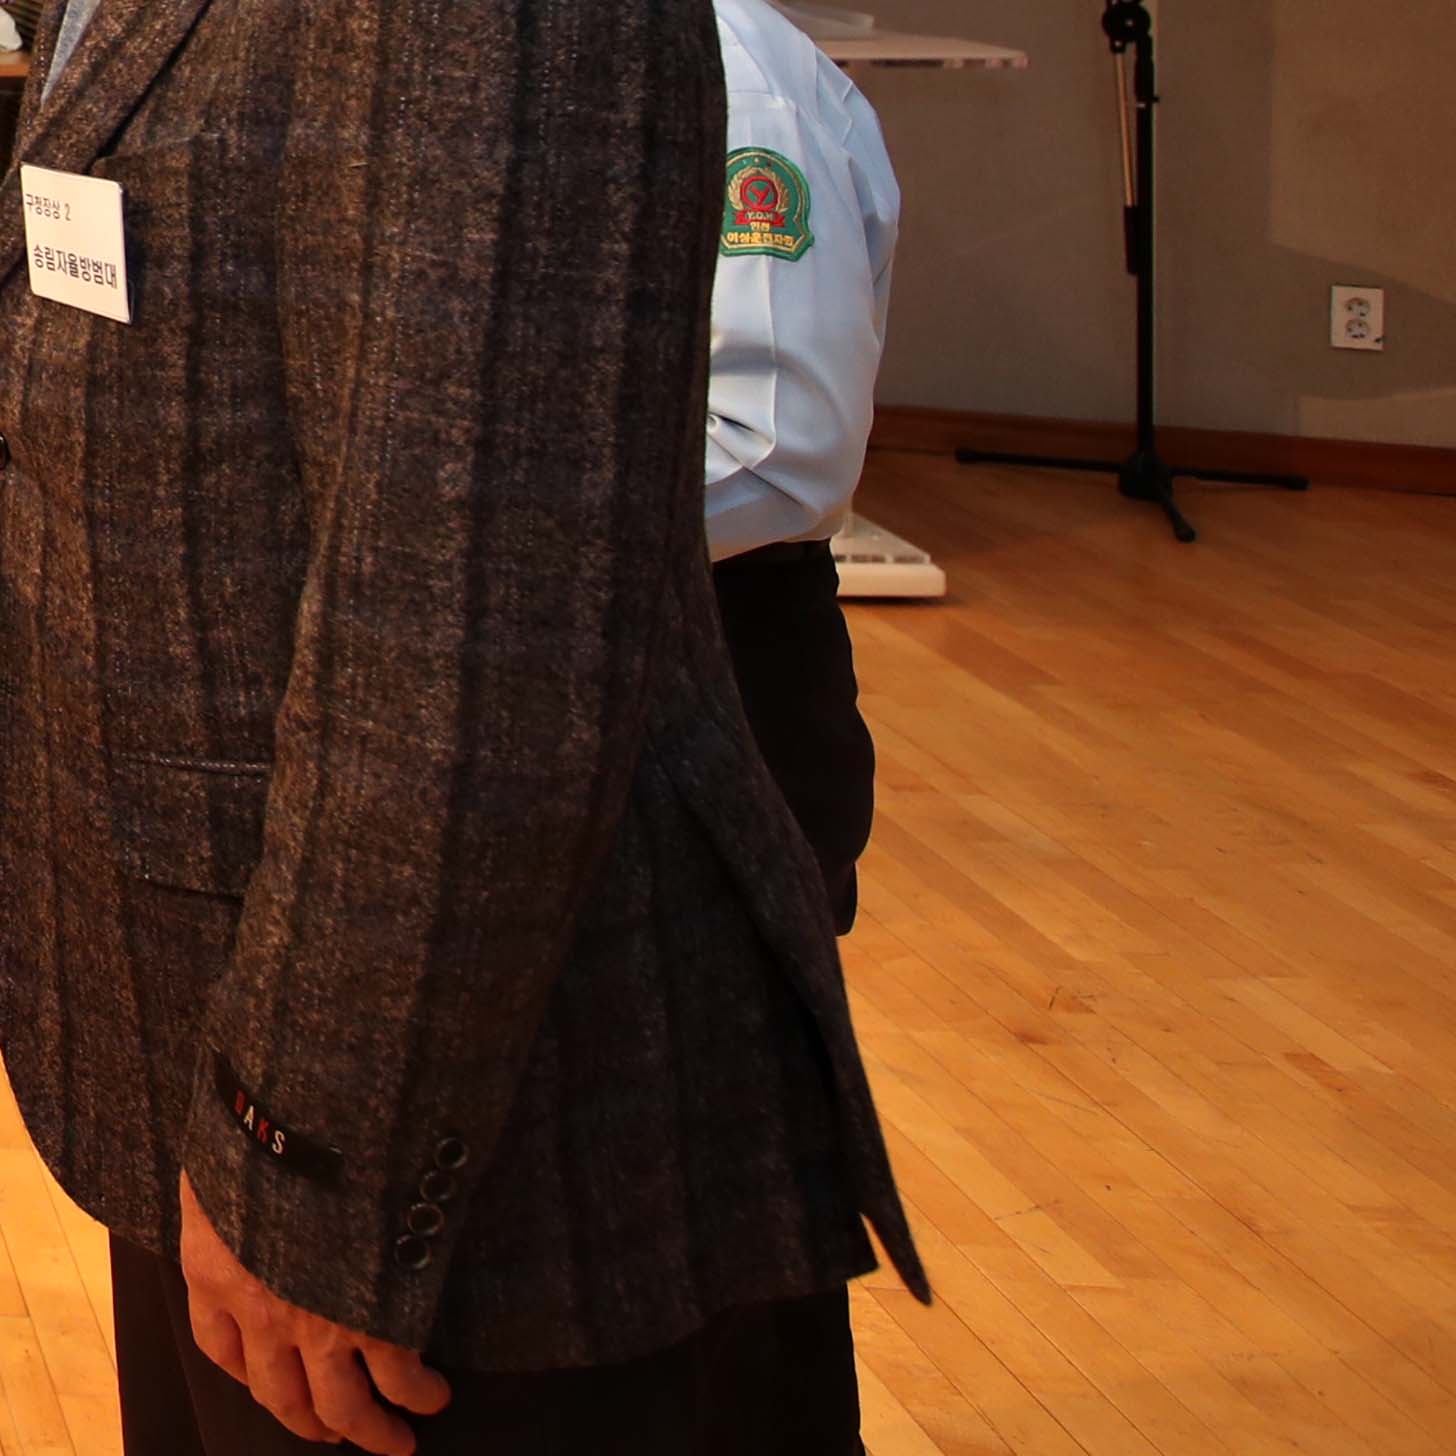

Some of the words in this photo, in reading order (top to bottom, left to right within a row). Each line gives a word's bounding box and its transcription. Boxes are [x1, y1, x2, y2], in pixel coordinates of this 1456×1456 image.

[25, 193, 61, 220] 구청장상
[64, 203, 72, 222] 2
[33, 244, 118, 289] 송림자율방범대
